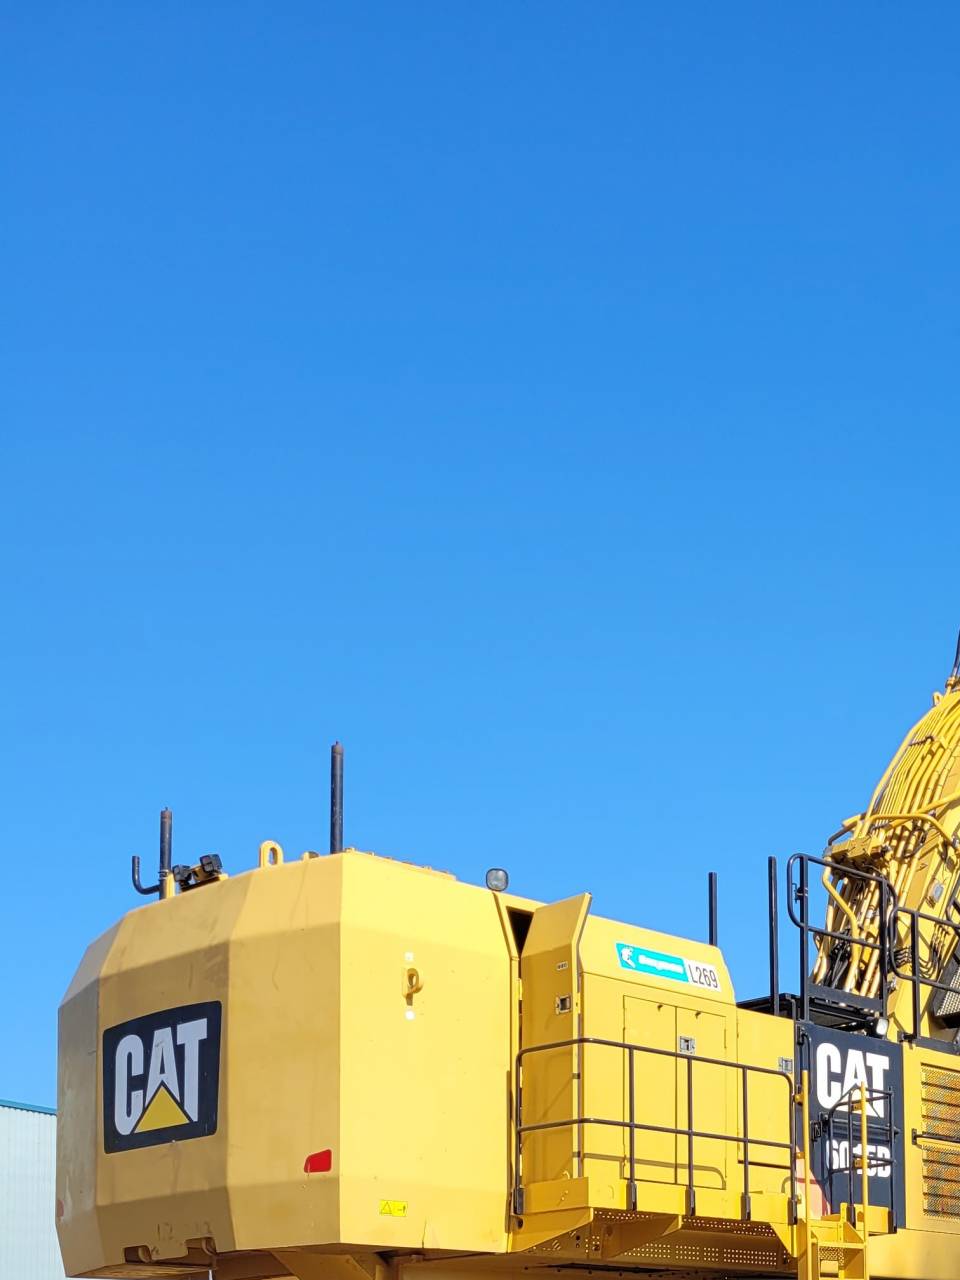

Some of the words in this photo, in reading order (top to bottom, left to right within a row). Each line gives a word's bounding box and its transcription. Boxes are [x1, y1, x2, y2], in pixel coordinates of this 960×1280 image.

[688, 963, 718, 989] L269
[114, 1017, 208, 1136] CAT
[816, 1042, 890, 1118] CAT
